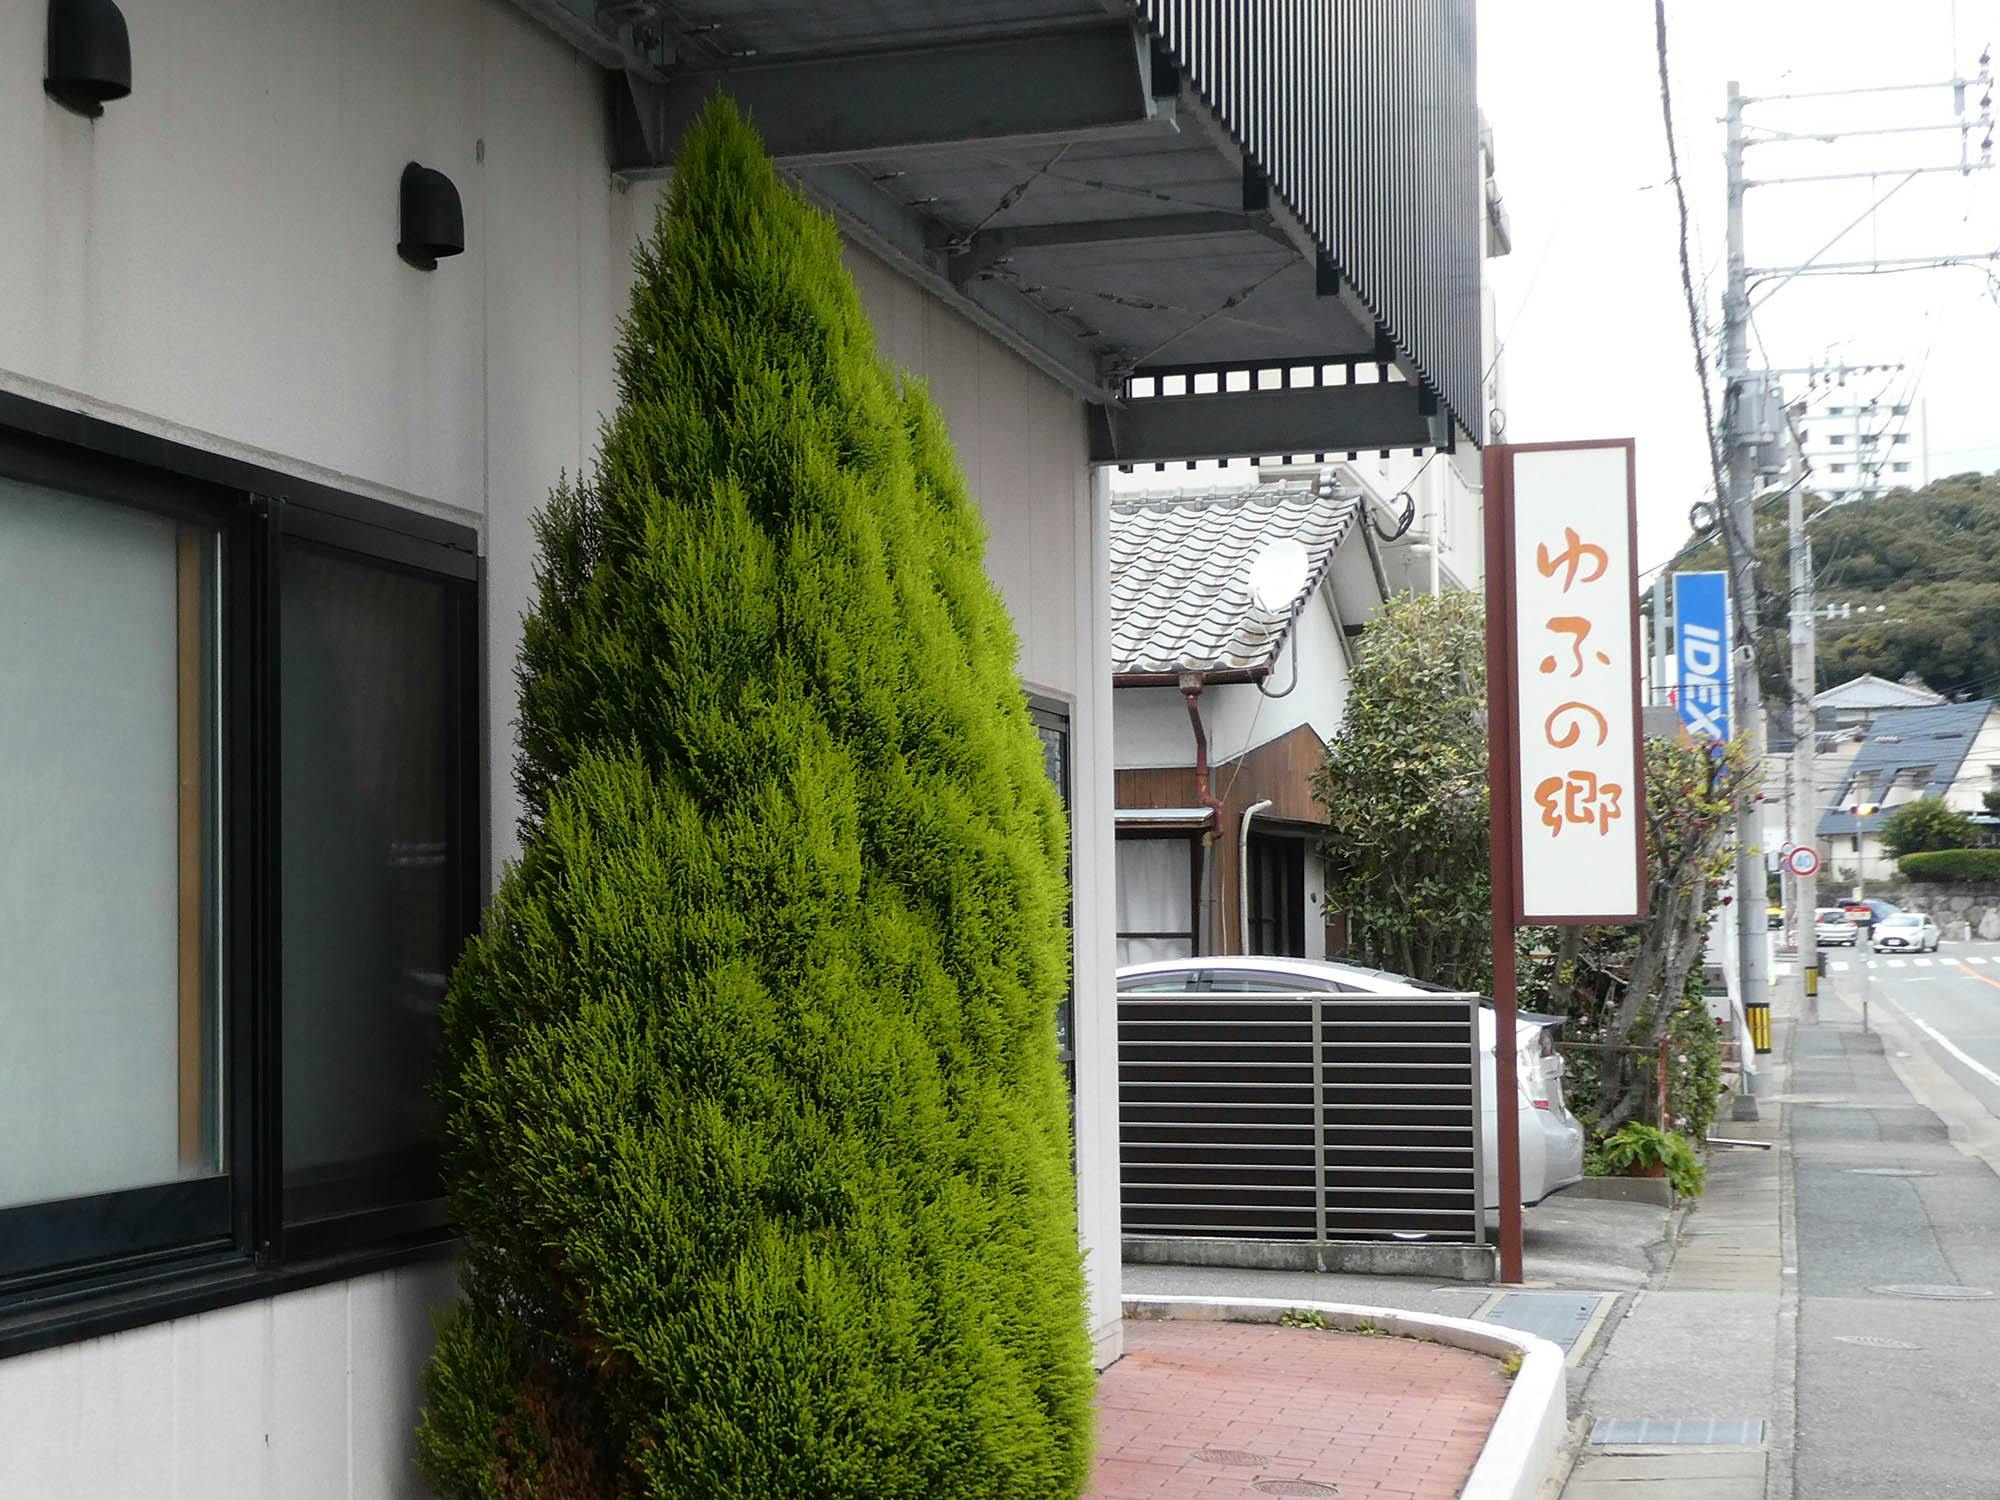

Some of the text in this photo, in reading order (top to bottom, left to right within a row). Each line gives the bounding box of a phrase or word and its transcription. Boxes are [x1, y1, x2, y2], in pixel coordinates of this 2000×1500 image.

[1534, 526, 1622, 838] ゆふの郷
[1684, 623, 1722, 739] IDEX
